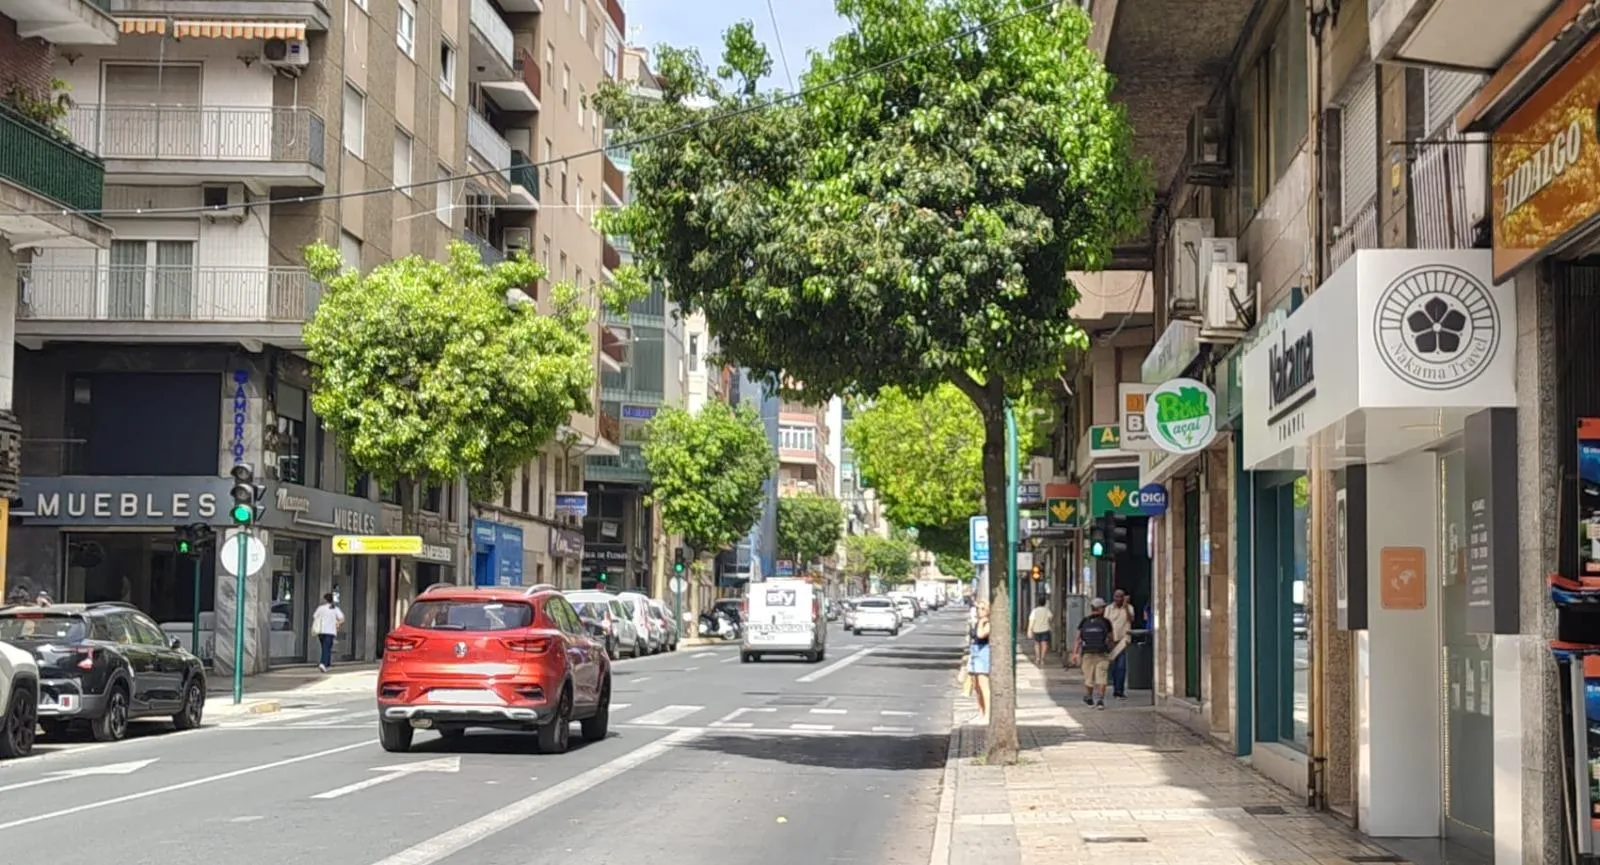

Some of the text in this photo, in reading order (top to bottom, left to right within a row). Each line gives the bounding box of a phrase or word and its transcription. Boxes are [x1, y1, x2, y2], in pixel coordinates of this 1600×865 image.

[1501, 119, 1581, 219] HIDALGO
[1268, 328, 1314, 410] Nakama
[1390, 336, 1490, 380] Nakama Travel
[1278, 411, 1305, 442] TRAVEL
[37, 493, 217, 517] MUEBLES
[1140, 492, 1166, 504] DIGI
[333, 507, 376, 535] MUEBLES
